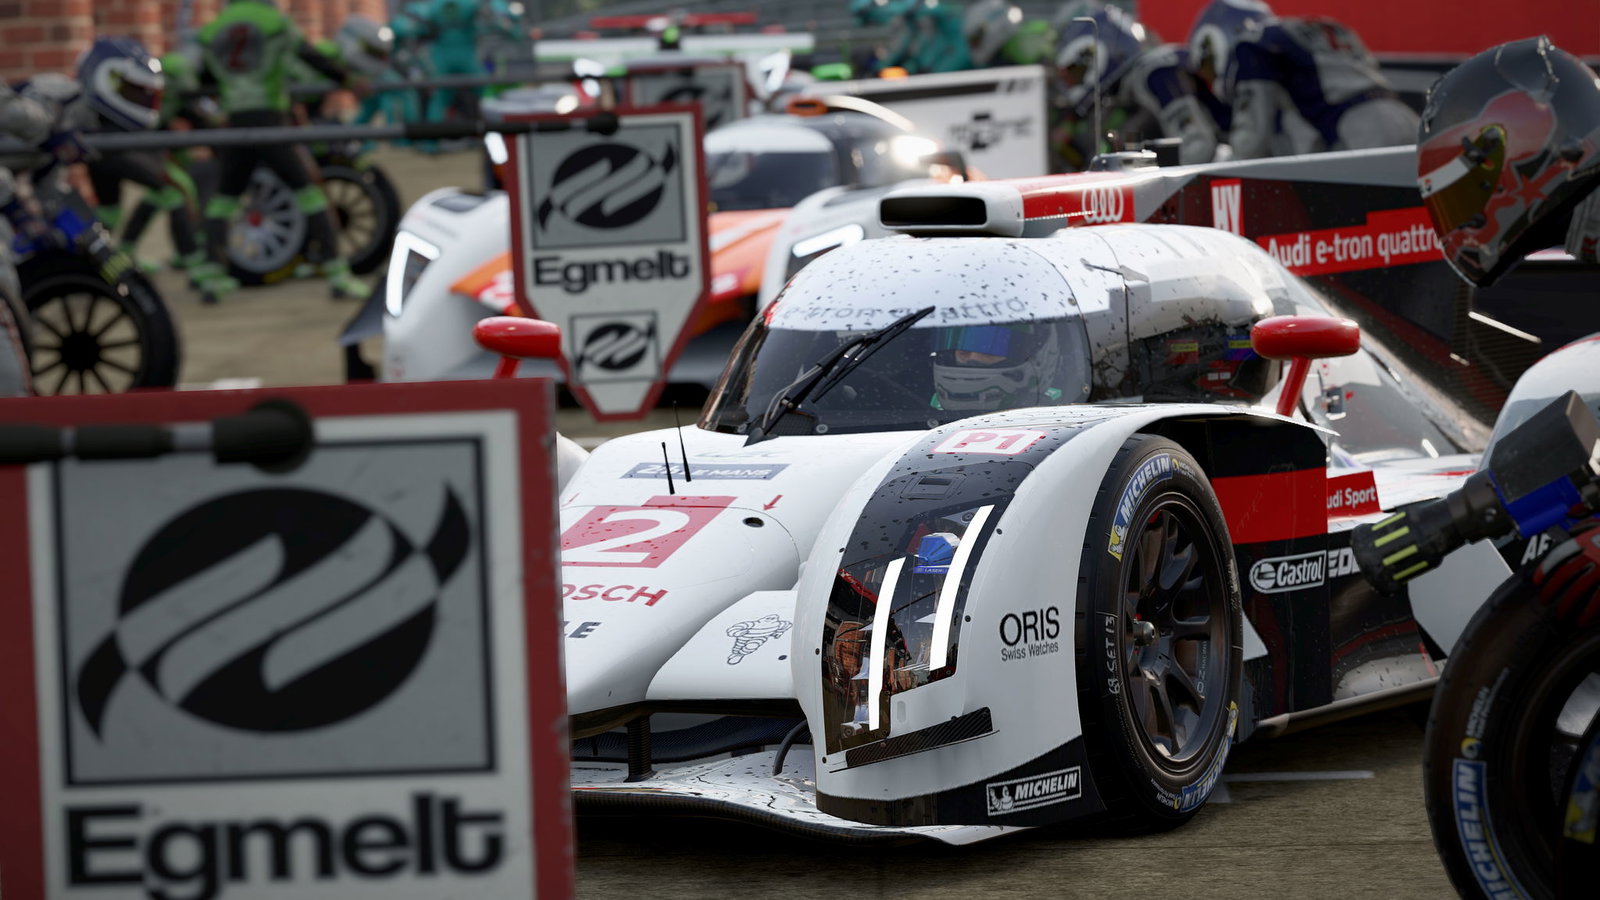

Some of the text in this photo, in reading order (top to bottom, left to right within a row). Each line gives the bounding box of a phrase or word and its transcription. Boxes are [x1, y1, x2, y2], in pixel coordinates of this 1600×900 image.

[1211, 184, 1241, 237] HY
[1268, 233, 1311, 267] Audi
[1315, 229, 1373, 264] e-tron
[534, 251, 690, 294] Egmelt
[953, 431, 1025, 450] P1
[1119, 457, 1170, 525] MICHELIN
[1344, 487, 1376, 509] Sport
[562, 509, 690, 563] 2
[1276, 556, 1323, 587] Castrol
[999, 606, 1060, 647] ORIS
[1001, 641, 1059, 662] Swiss Watches
[1105, 637, 1118, 672] SET
[1014, 772, 1078, 800] MICHELIN
[63, 791, 506, 900] Egmelt
